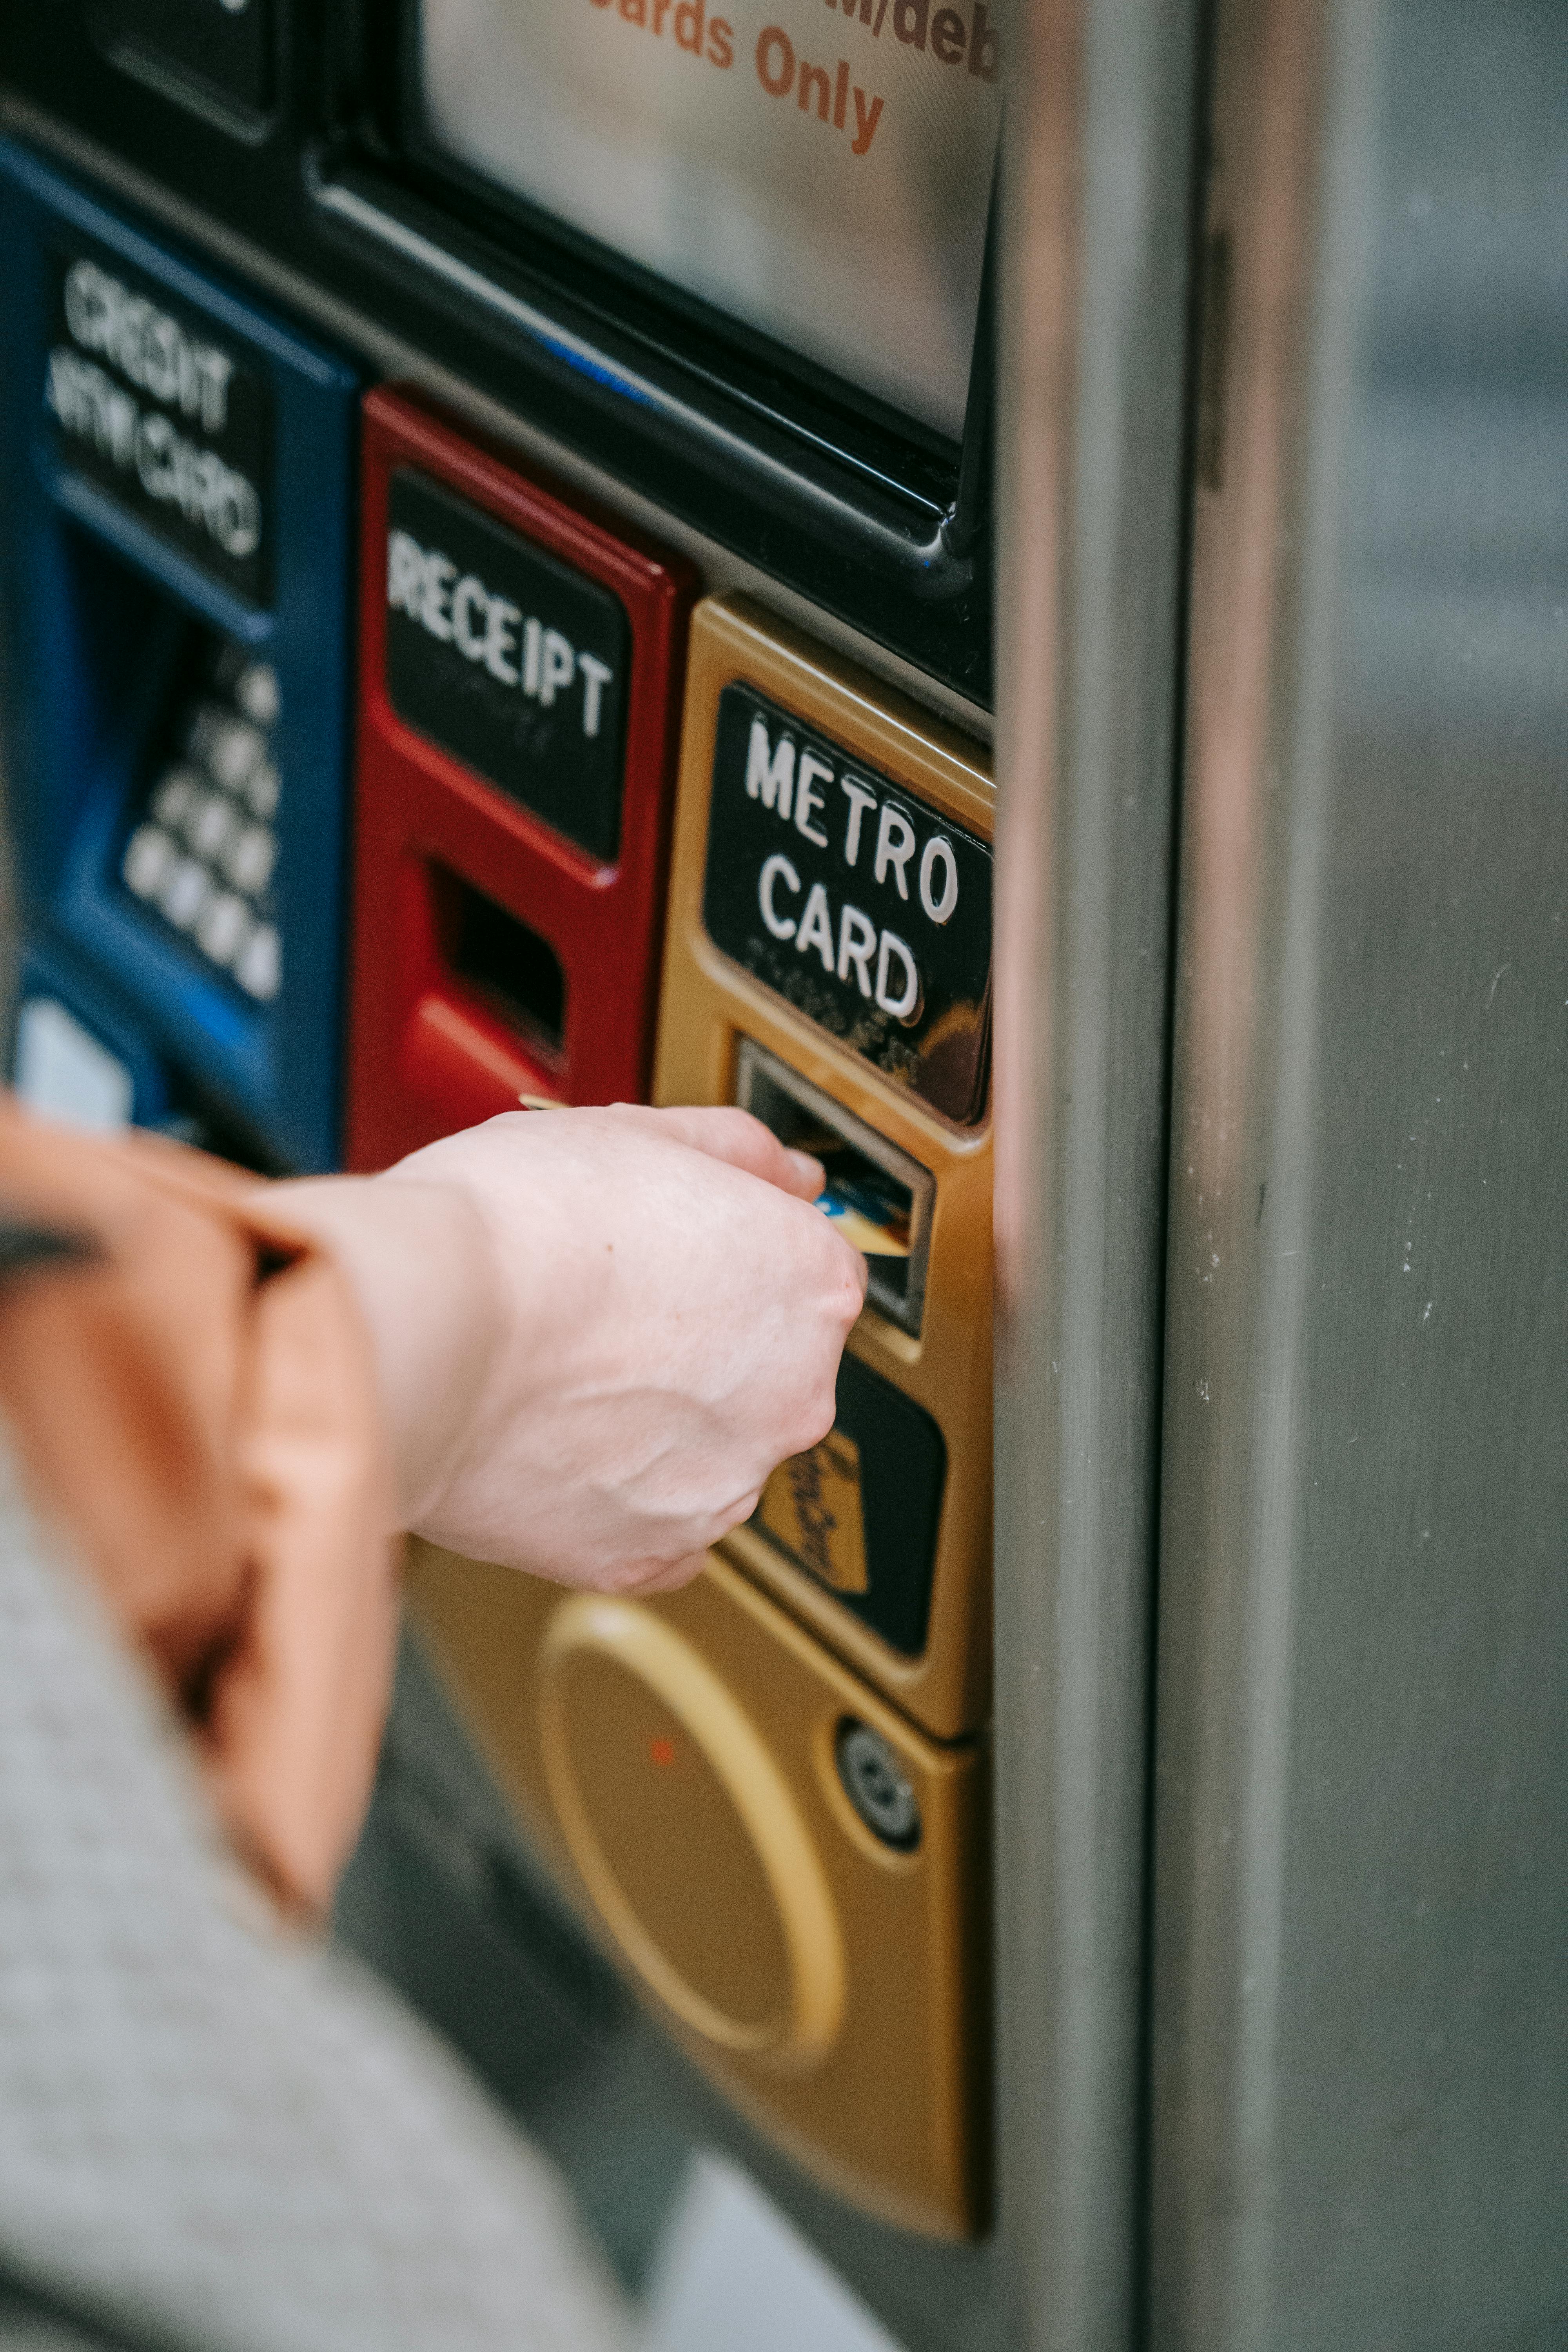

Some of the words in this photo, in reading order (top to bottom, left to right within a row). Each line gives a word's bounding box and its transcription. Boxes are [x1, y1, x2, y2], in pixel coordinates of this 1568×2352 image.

[755, 25, 885, 156] Only
[65, 259, 232, 434] CREDIT
[135, 412, 262, 558] CARD
[387, 529, 613, 738] RECEIPT
[746, 719, 958, 924] METRO
[758, 854, 918, 1019] CARD
